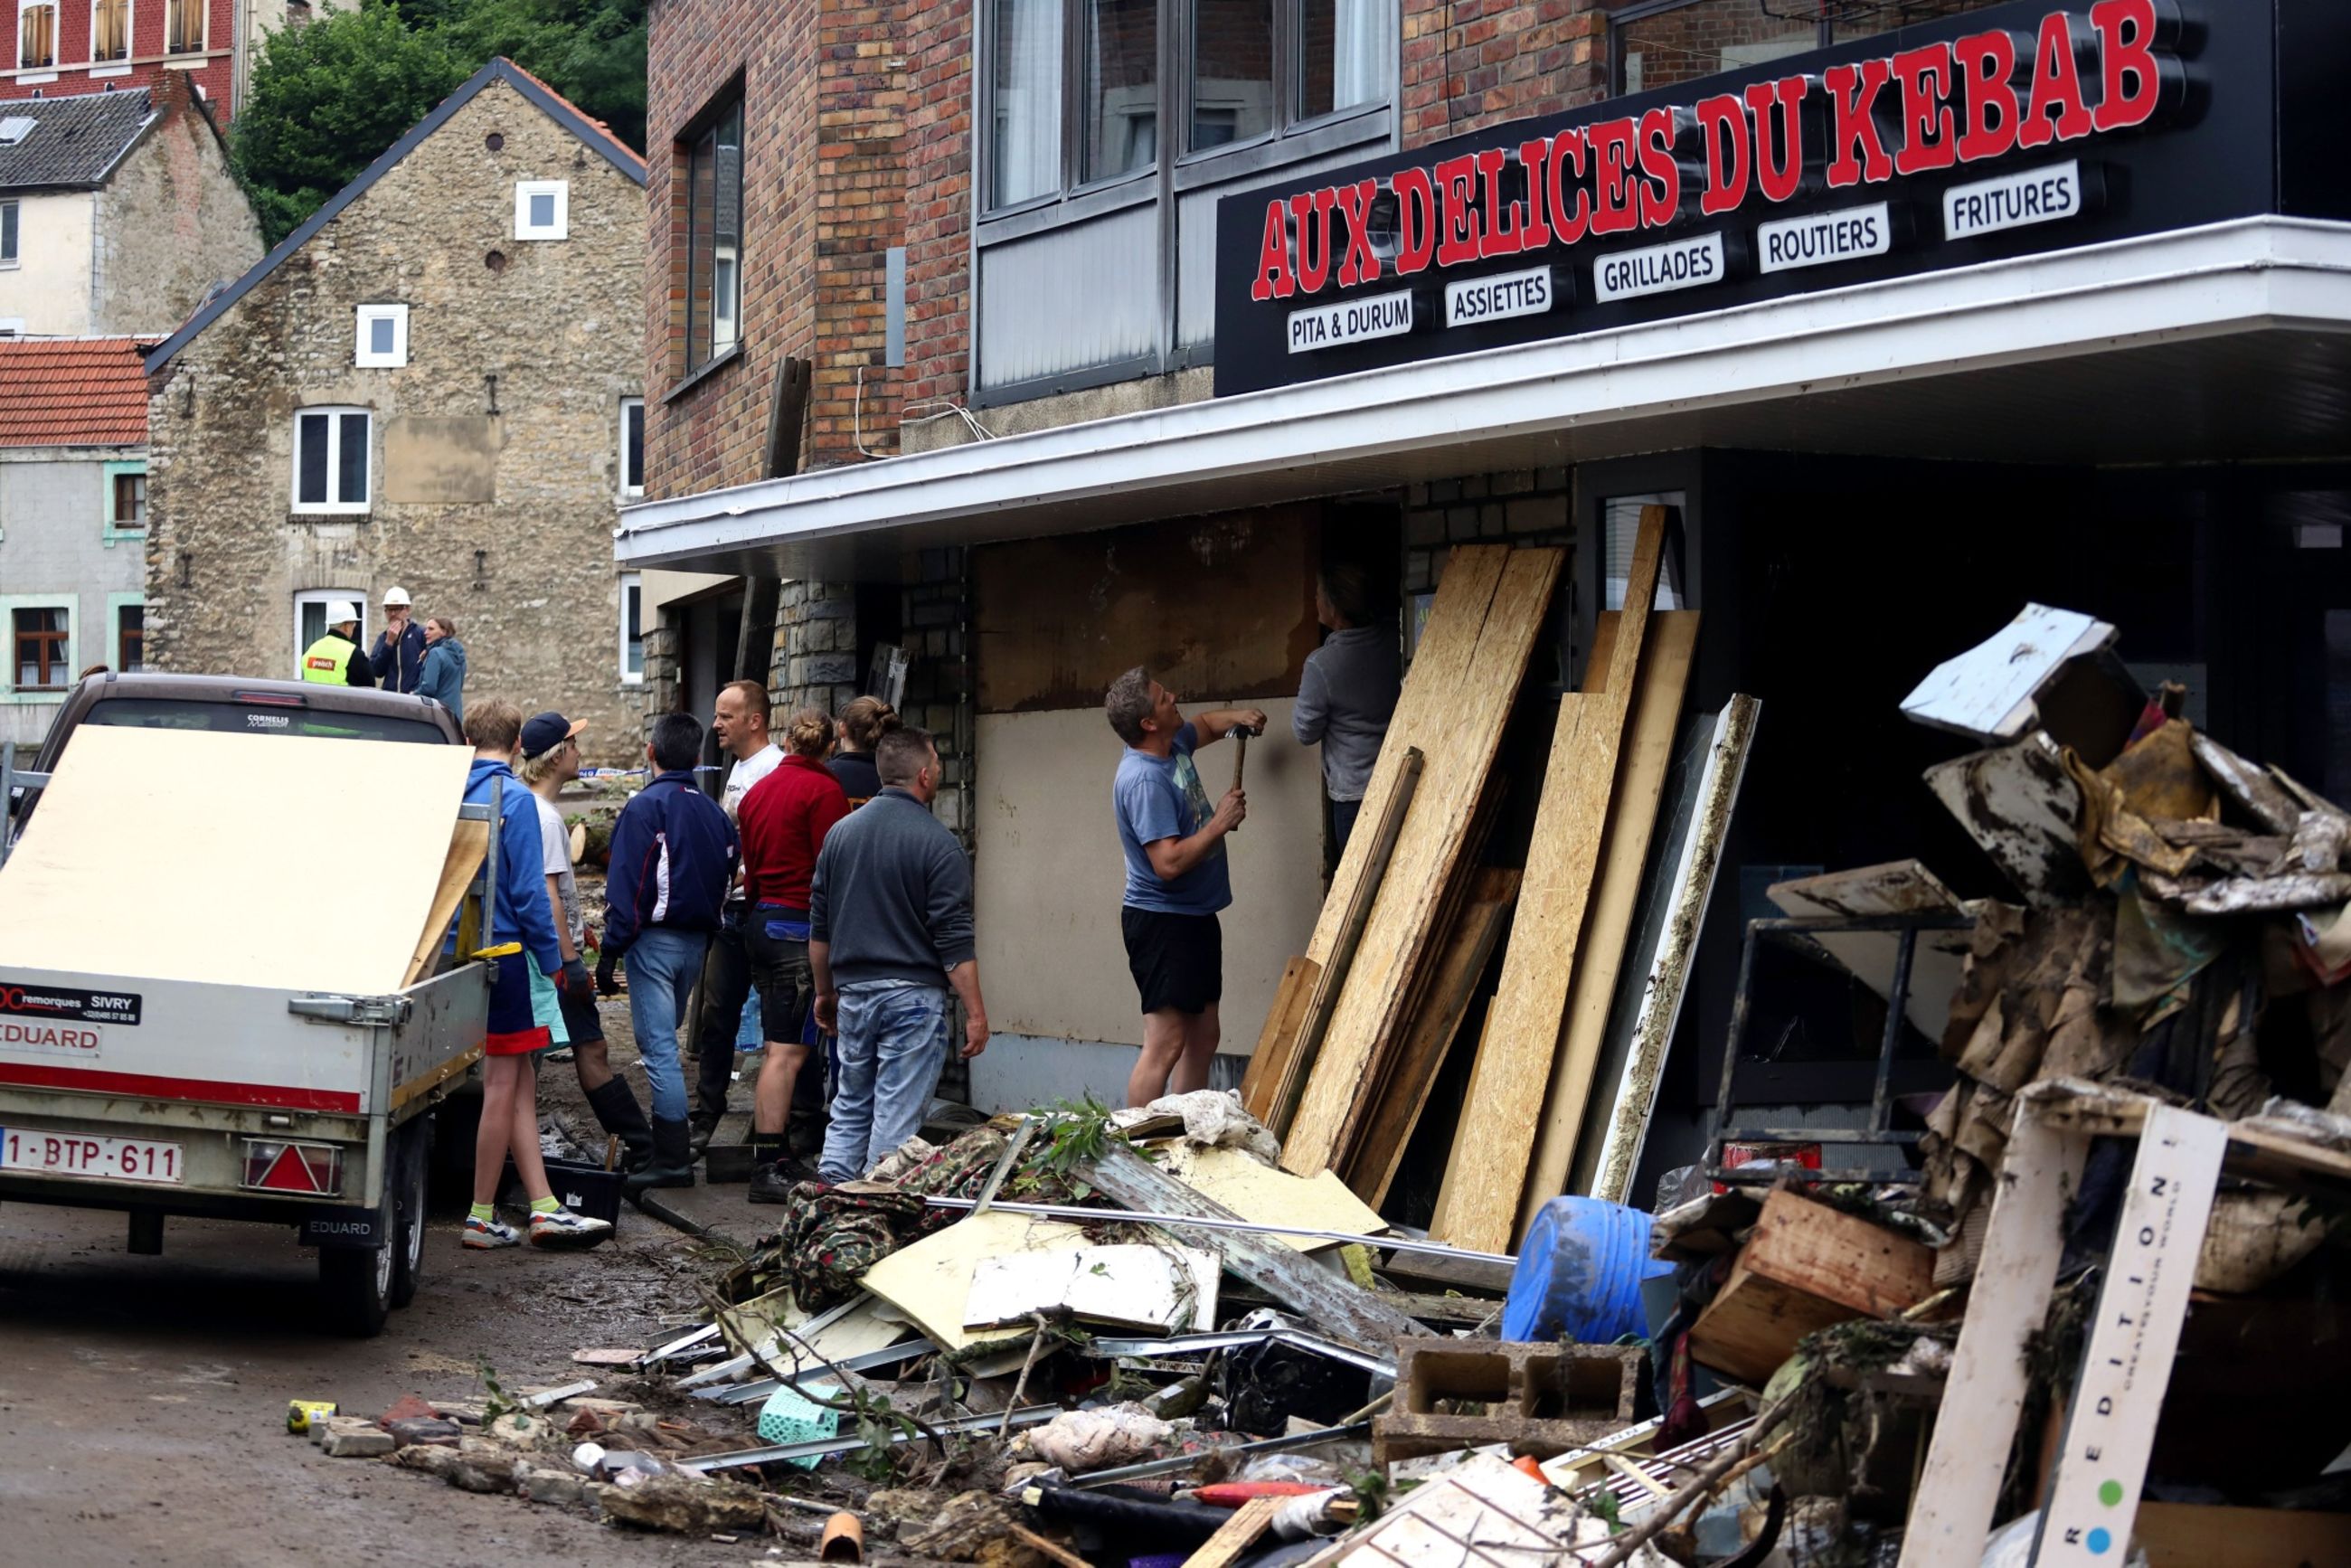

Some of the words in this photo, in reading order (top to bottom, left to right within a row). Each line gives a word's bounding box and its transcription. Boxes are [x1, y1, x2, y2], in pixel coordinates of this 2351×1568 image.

[1251, 177, 1381, 301] AUX
[1393, 105, 1680, 276] DELICES
[1696, 74, 1808, 216] DU
[1825, 0, 2159, 189] KEBAB
[1954, 177, 2072, 231] FRITURES
[1770, 217, 1878, 263] ROUTIERS
[1604, 245, 1714, 291] GRILLADES
[1454, 276, 1547, 320] ASSIETTES
[1292, 316, 1327, 345] PITA
[1331, 312, 1342, 338] &
[1347, 298, 1410, 333] DURUM
[247, 714, 289, 723] CORNELIS
[22, 995, 82, 1008] remorques
[90, 996, 132, 1011] SIVRY
[0, 1024, 99, 1049] DUARD
[309, 1221, 372, 1235] EDUARD
